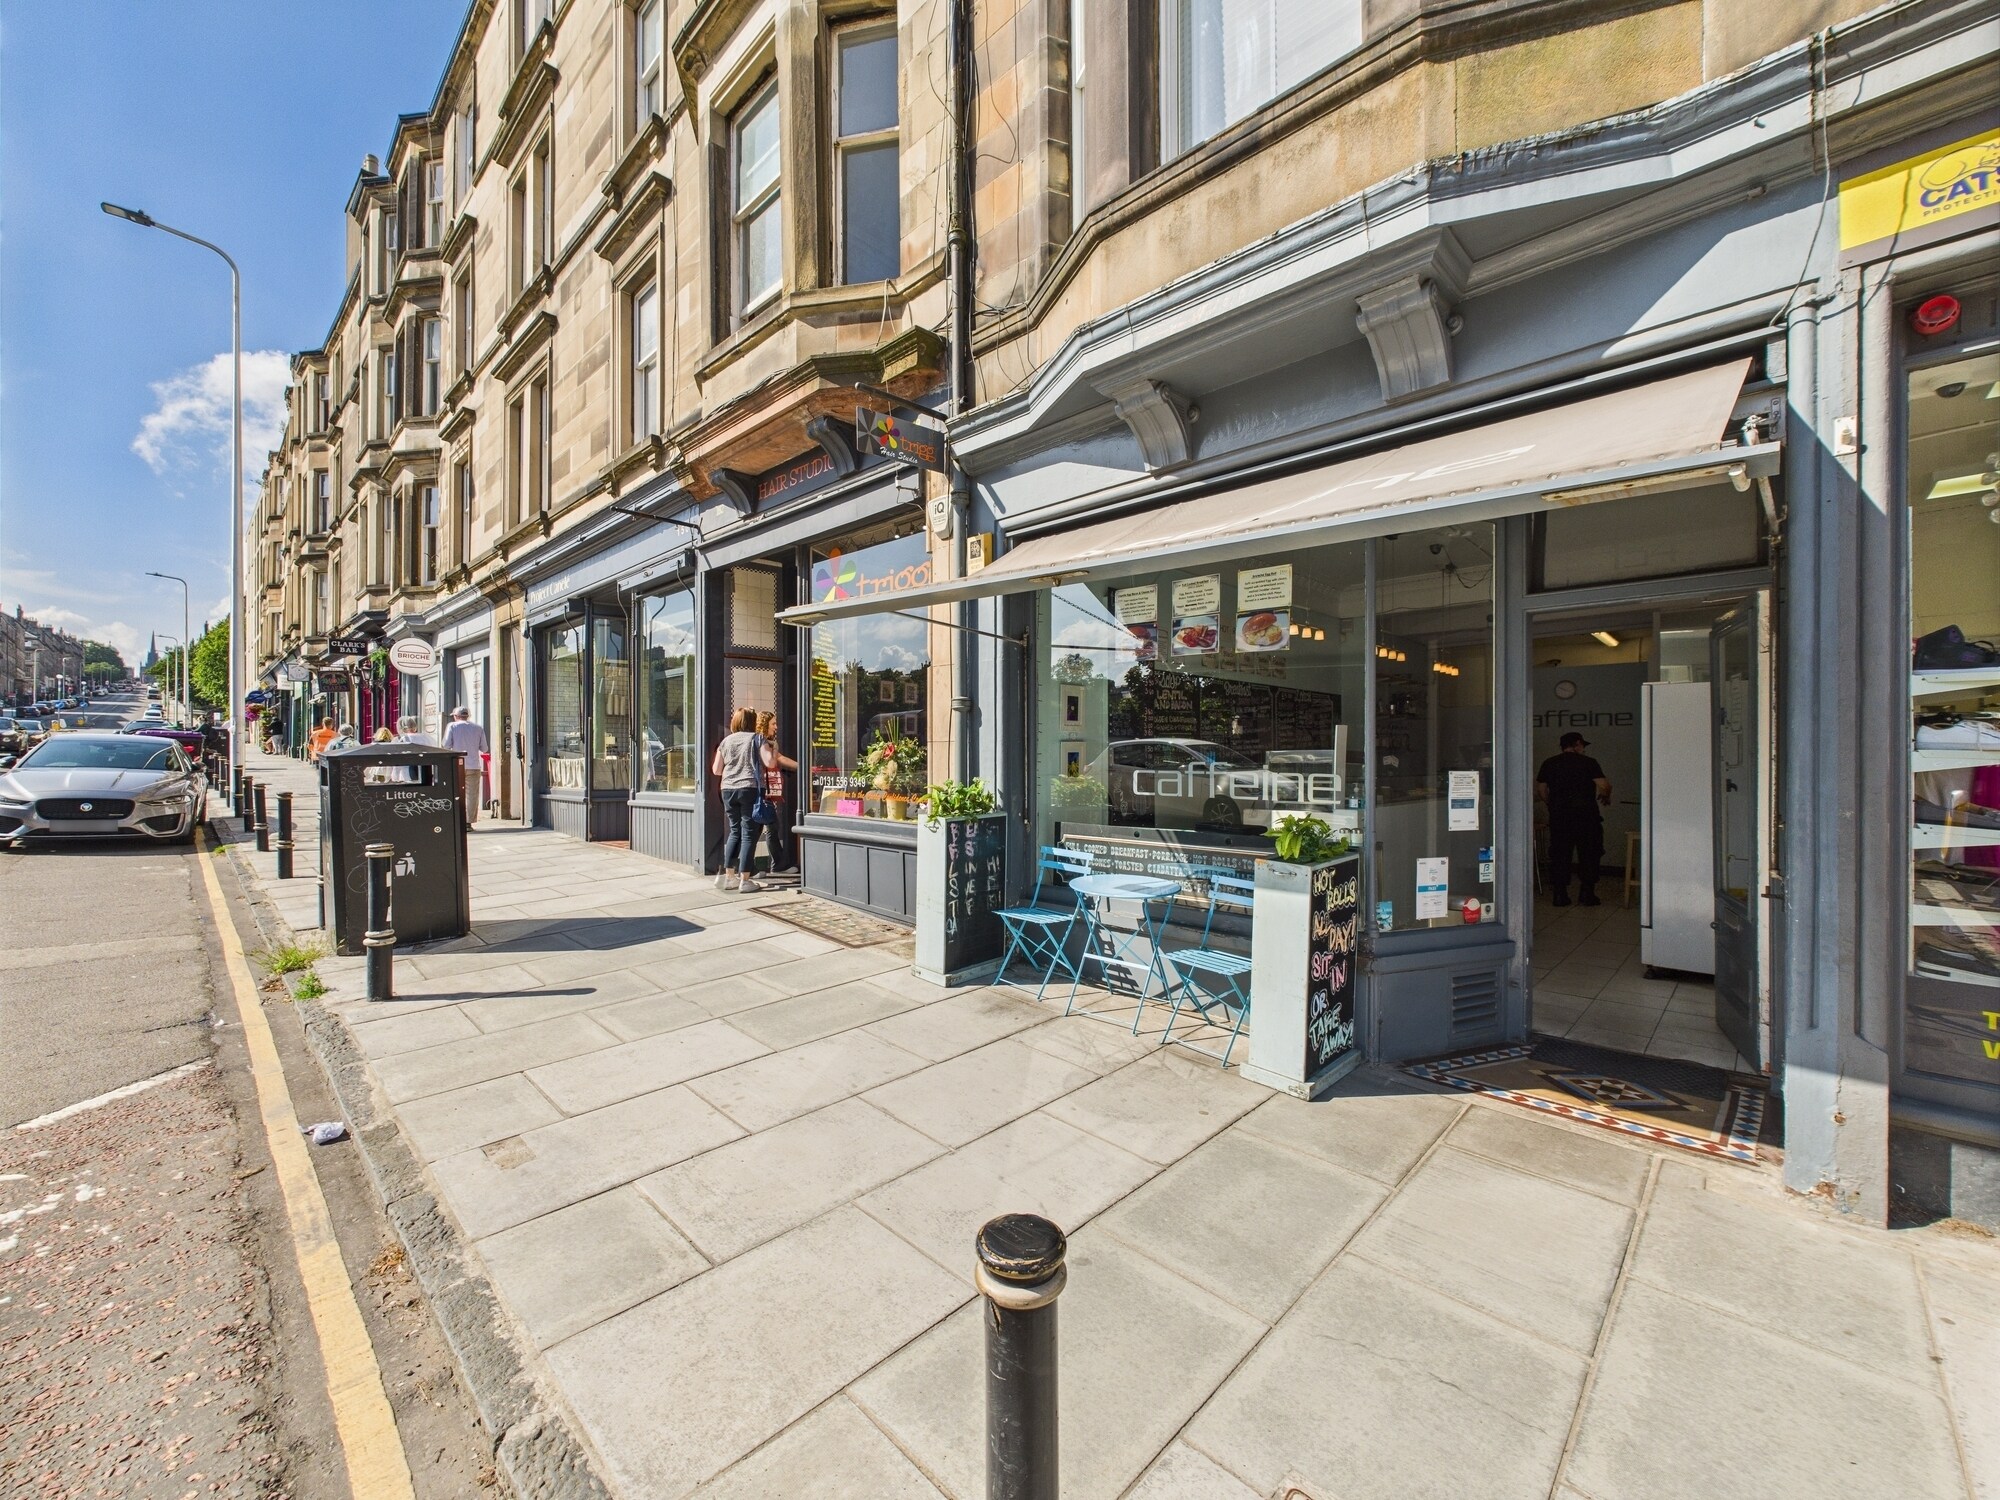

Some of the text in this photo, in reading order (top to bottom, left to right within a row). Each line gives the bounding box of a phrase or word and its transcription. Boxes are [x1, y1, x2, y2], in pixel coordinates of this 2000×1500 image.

[1923, 189, 2000, 217] PROTECTI
[880, 446, 918, 464] Hair Studio
[900, 436, 937, 463] trigg
[758, 474, 788, 500] HAIR
[934, 502, 945, 515] iQ
[530, 586, 549, 605] Project
[1533, 710, 1633, 728] affeine
[386, 791, 418, 800] Litter
[820, 776, 834, 786] 0131
[836, 777, 848, 787] 556
[849, 777, 866, 788] 9349
[1132, 761, 1342, 805] caffeine
[1083, 844, 1108, 855] COOKED
[1110, 846, 1149, 859] BREAKFAST
[1152, 850, 1188, 863] PORRIDGE
[1192, 854, 1207, 865] HOT
[1212, 856, 1237, 869] ROLLS
[1242, 859, 1255, 870] TO
[1114, 860, 1144, 872] TOASTED
[1313, 867, 1336, 896] HOT
[1327, 877, 1357, 911] ROLLS
[1328, 913, 1357, 954] DAY!
[1312, 952, 1333, 981] SIT
[1330, 960, 1348, 995] IN
[1311, 989, 1329, 1019] OR
[1309, 1003, 1342, 1051] TAKE
